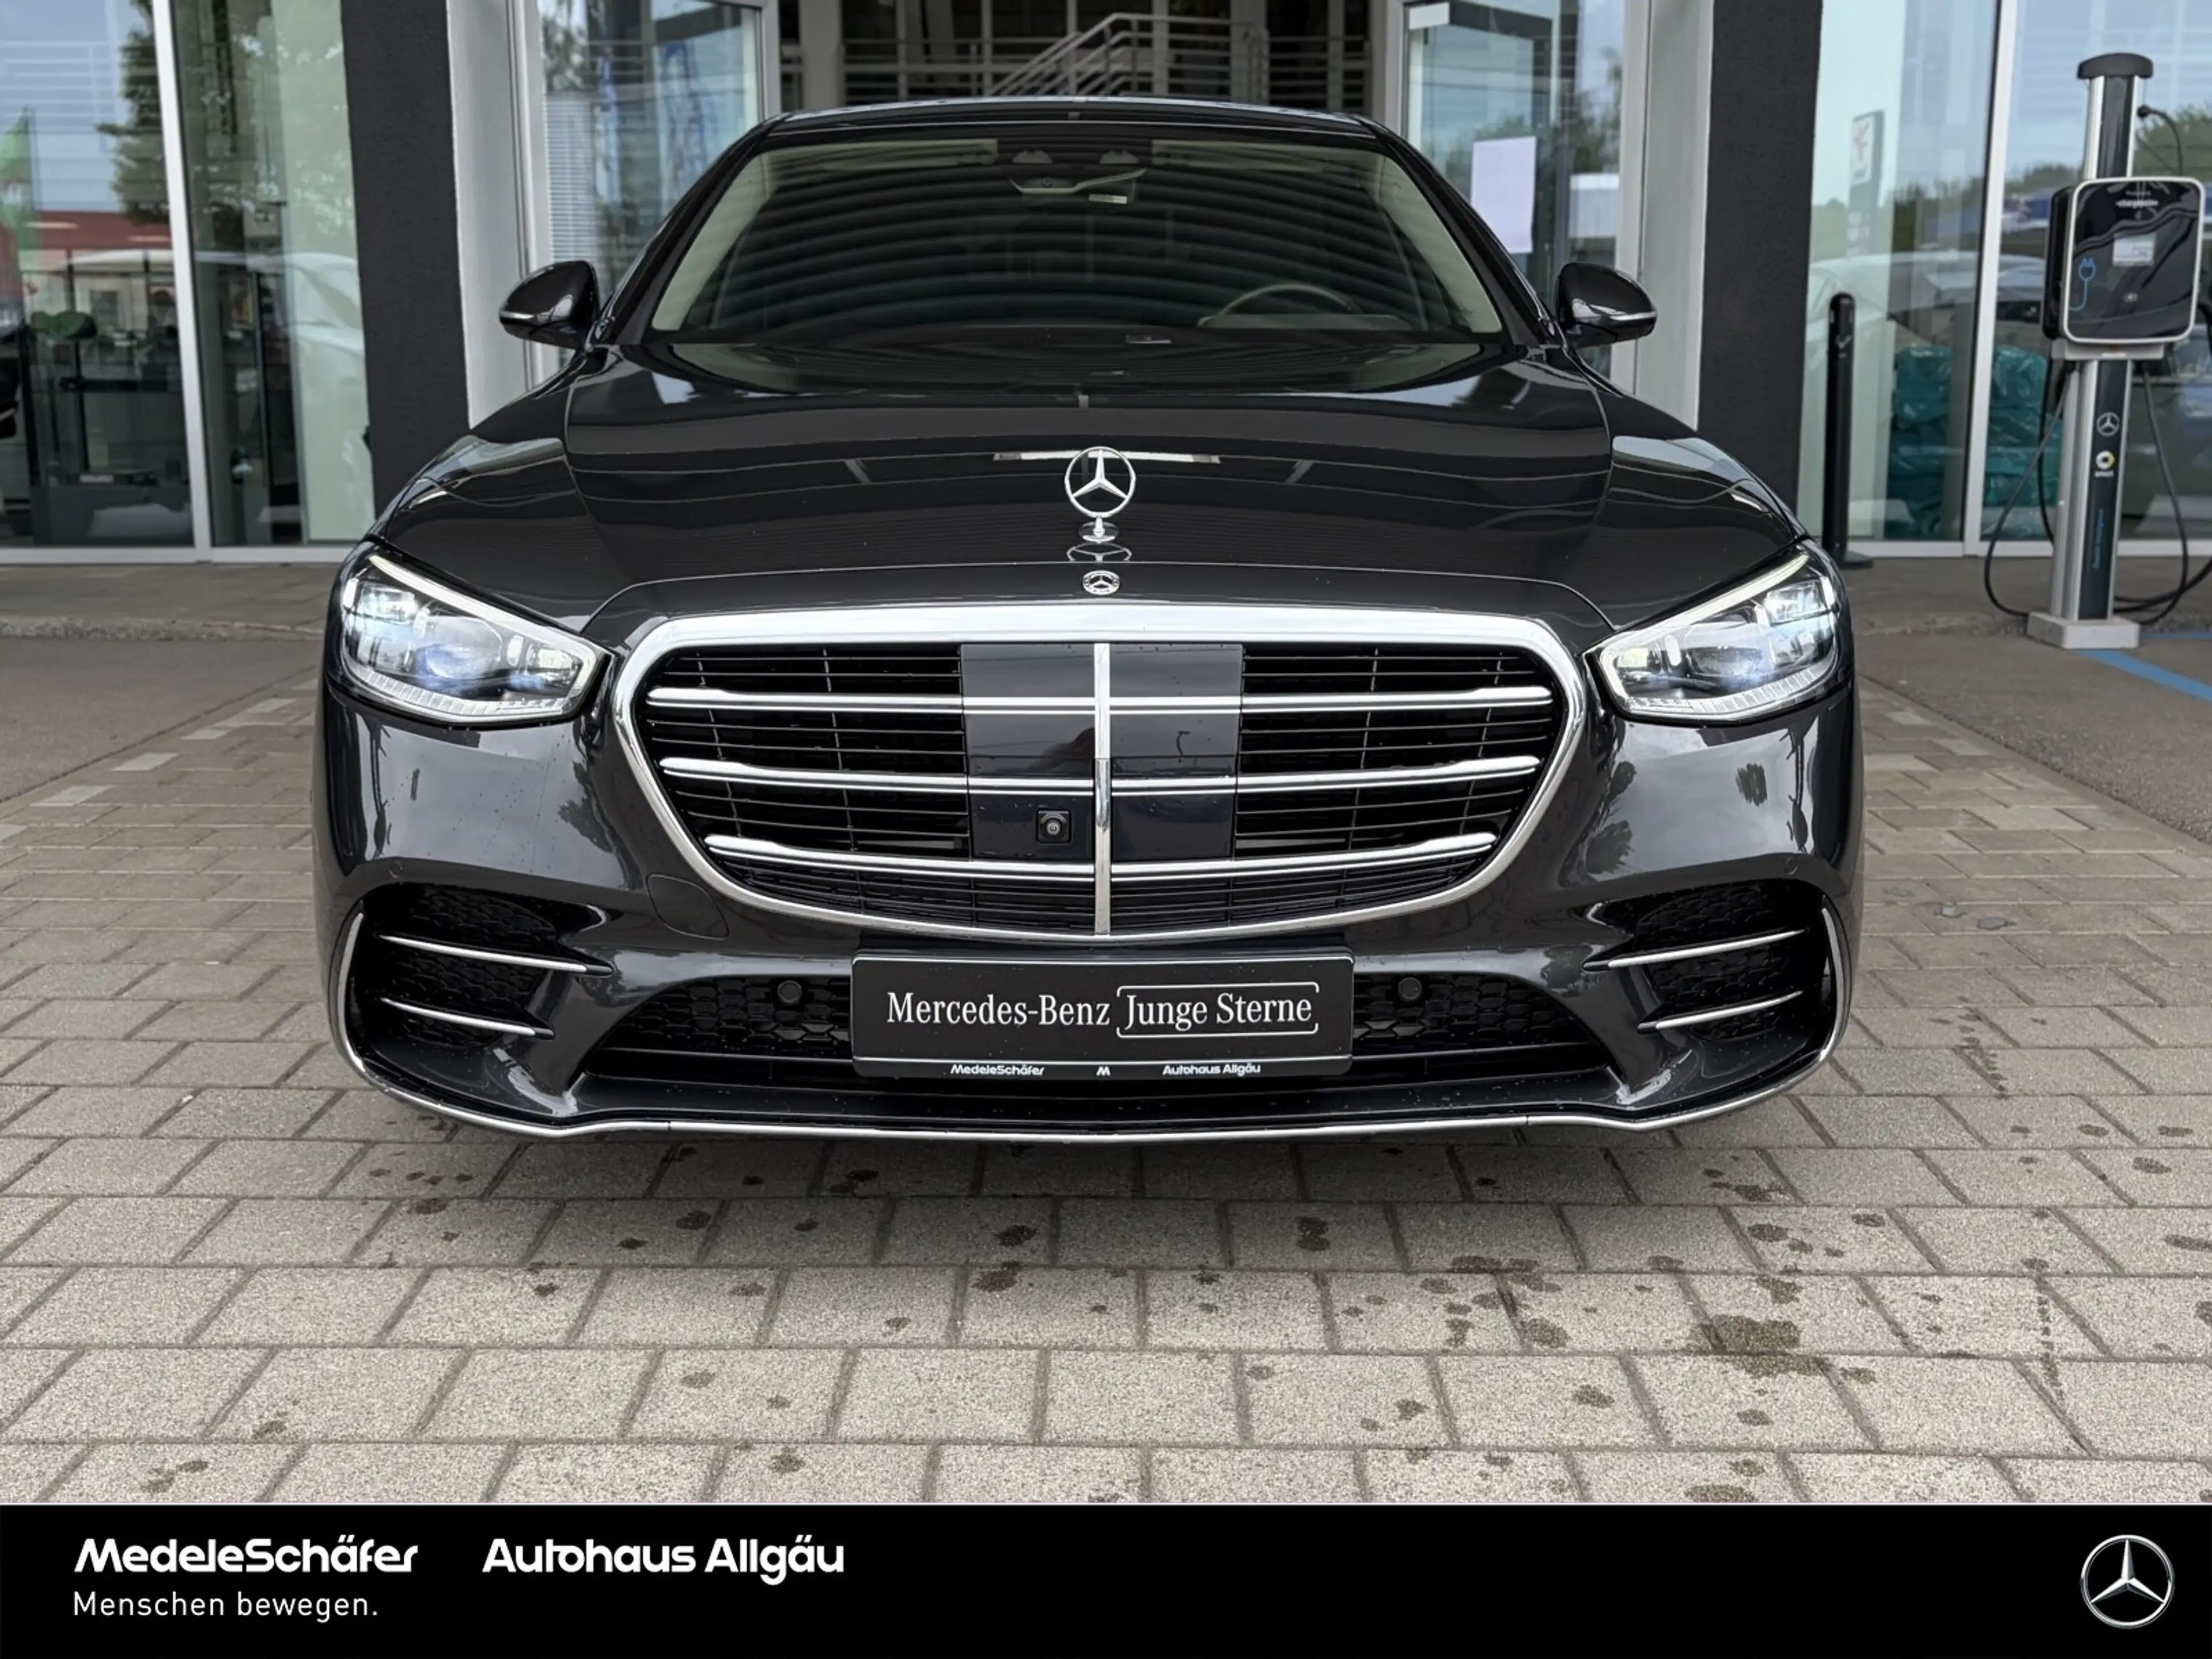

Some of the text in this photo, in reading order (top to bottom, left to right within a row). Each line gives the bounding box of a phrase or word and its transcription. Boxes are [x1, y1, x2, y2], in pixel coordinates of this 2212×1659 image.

[887, 991, 1312, 1031] Mercedes-Benz Junge Sterne
[950, 1064, 1045, 1076] MedeleSchäfer
[1162, 1063, 1262, 1077] Autohaus Allgäu
